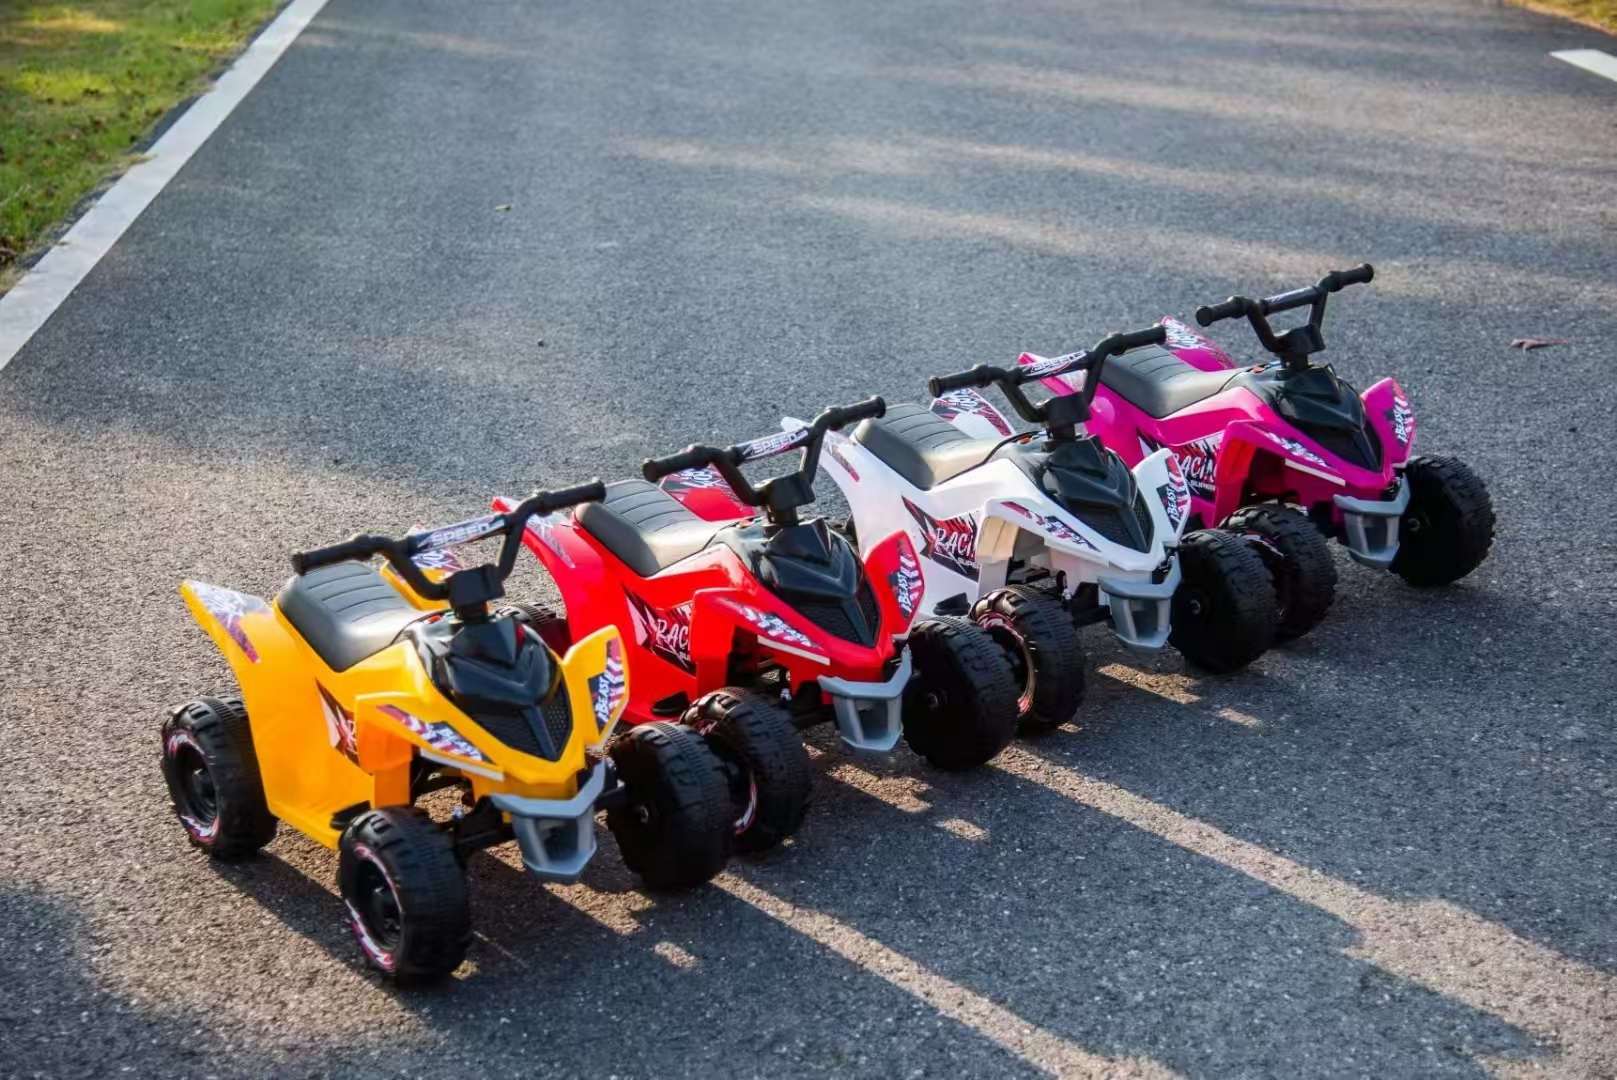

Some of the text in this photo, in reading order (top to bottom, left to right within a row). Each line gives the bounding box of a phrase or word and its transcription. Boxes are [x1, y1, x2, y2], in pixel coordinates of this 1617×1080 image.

[751, 433, 798, 454] SPEED
[1166, 486, 1181, 520] BEAST
[431, 524, 490, 546] SPEED
[896, 570, 913, 609] BEAST
[594, 675, 610, 717] BEAST
